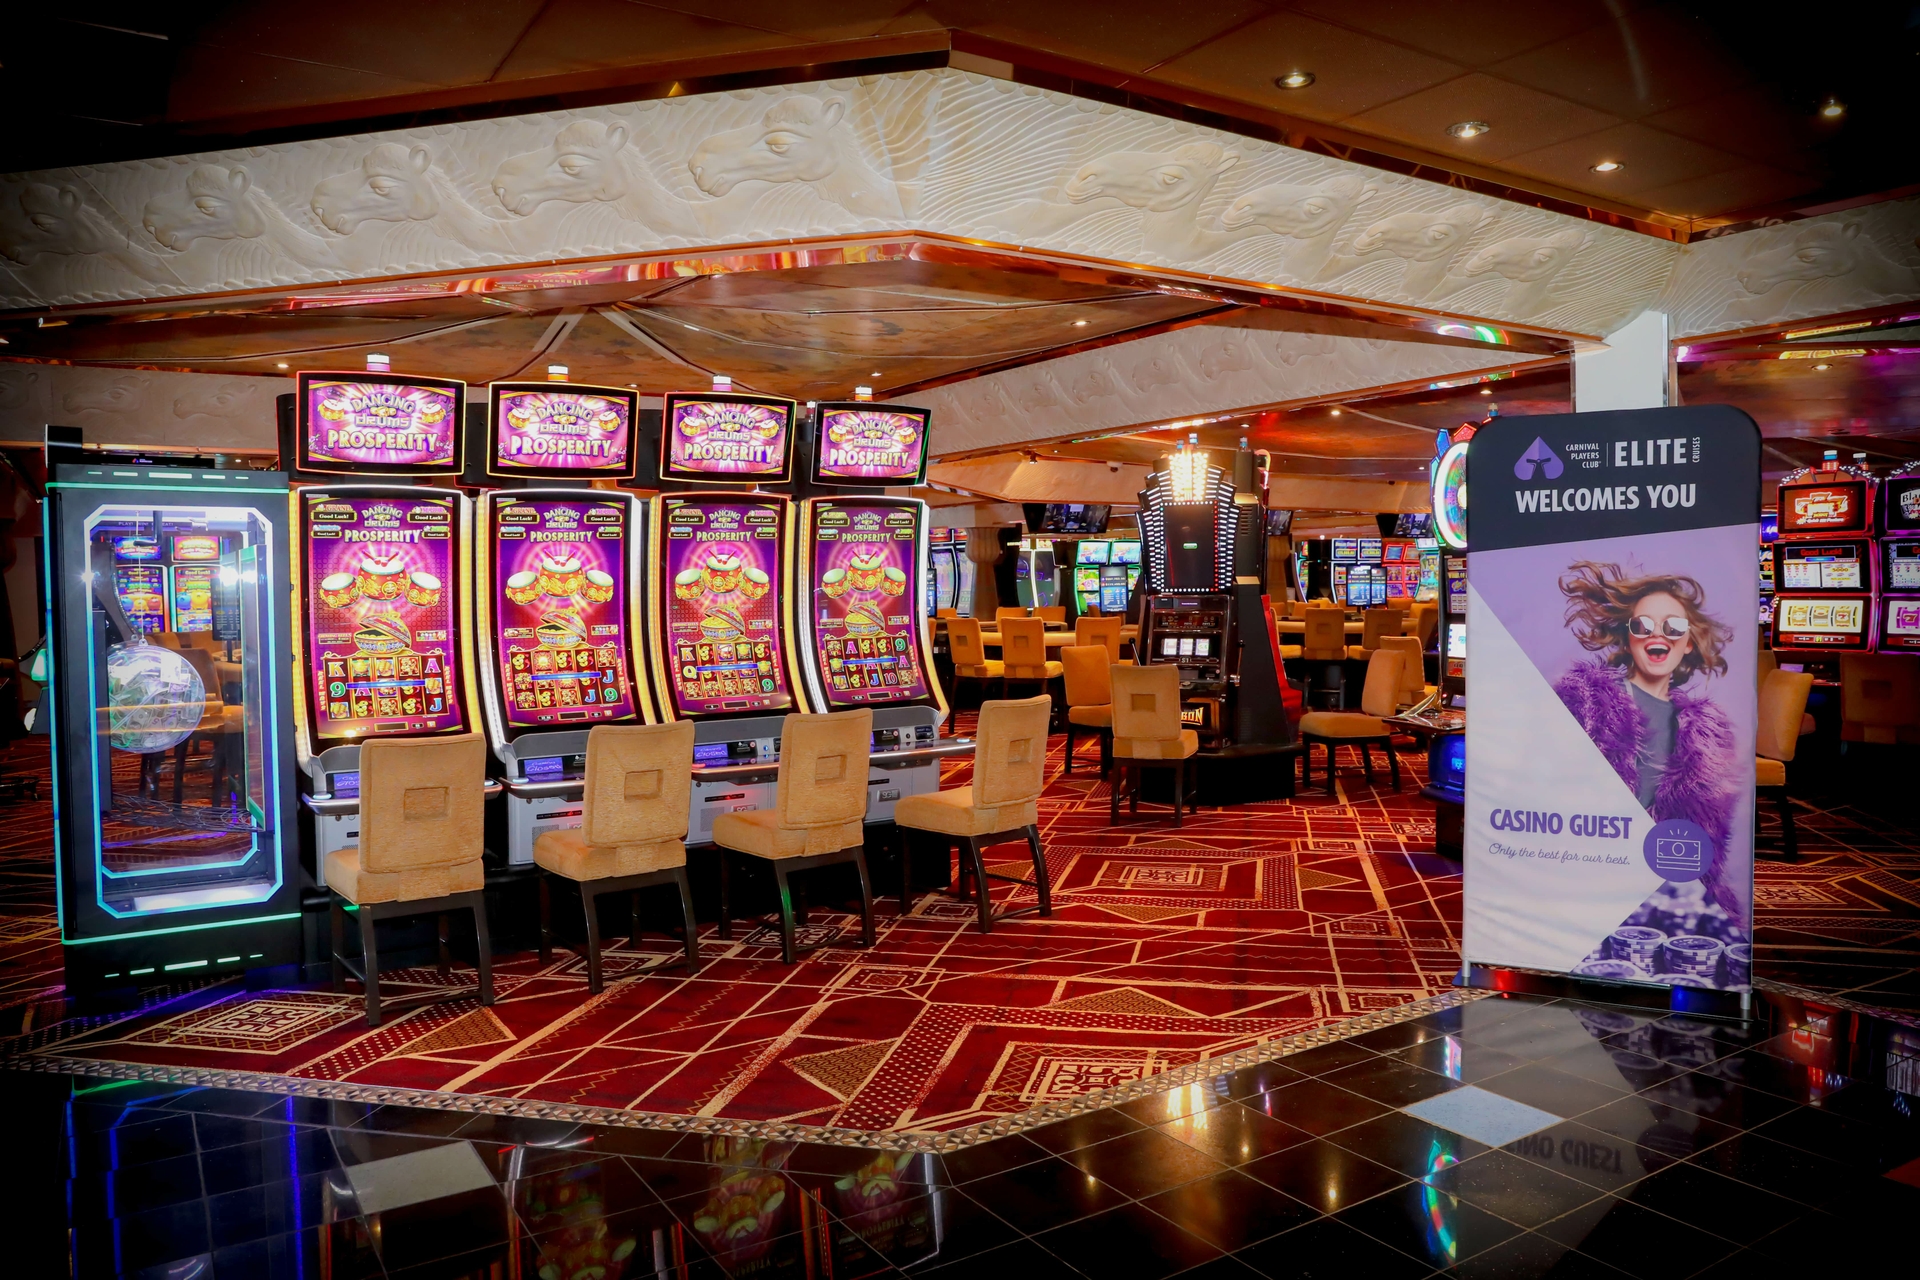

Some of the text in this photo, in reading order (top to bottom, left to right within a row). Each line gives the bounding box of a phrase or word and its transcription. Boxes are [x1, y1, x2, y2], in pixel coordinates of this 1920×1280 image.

[351, 394, 416, 413] DANCING
[536, 402, 593, 421] DANCING
[706, 411, 756, 429] DANCING
[851, 420, 896, 437] DANCING
[327, 430, 438, 452] PROSPERITY
[510, 435, 612, 456] PROSPERITY
[1566, 442, 1600, 452] CARNIVAL
[683, 442, 775, 463] PROSPERITY
[1570, 452, 1600, 460] PLAYERS
[1614, 438, 1687, 467] ELITE
[1692, 436, 1700, 463] CRUISES
[829, 448, 909, 467] PROSPERITY
[1515, 484, 1696, 513] WELCOMES YOU
[361, 505, 402, 518] DANCING
[544, 508, 580, 521] DANCING
[709, 510, 741, 521] DANCING
[853, 513, 882, 523] DANCING
[344, 530, 420, 543] PROSPERITY
[530, 531, 593, 542] PROSPERITY
[696, 531, 751, 542] PROSPERITY
[842, 533, 891, 542] PROSPERITY
[846, 641, 858, 654] A
[895, 638, 906, 651] 9
[680, 648, 695, 661] K
[425, 658, 441, 673] A
[899, 656, 910, 668] A
[328, 662, 345, 677] K
[603, 670, 613, 683] J
[762, 678, 774, 692] 9
[884, 672, 898, 684] 10
[330, 682, 346, 697] 9
[585, 690, 596, 702] J
[604, 688, 618, 702] 9
[430, 698, 442, 712] J
[1490, 808, 1632, 839] CASINO GUEST
[1488, 843, 1630, 865] Only the best for our best.
